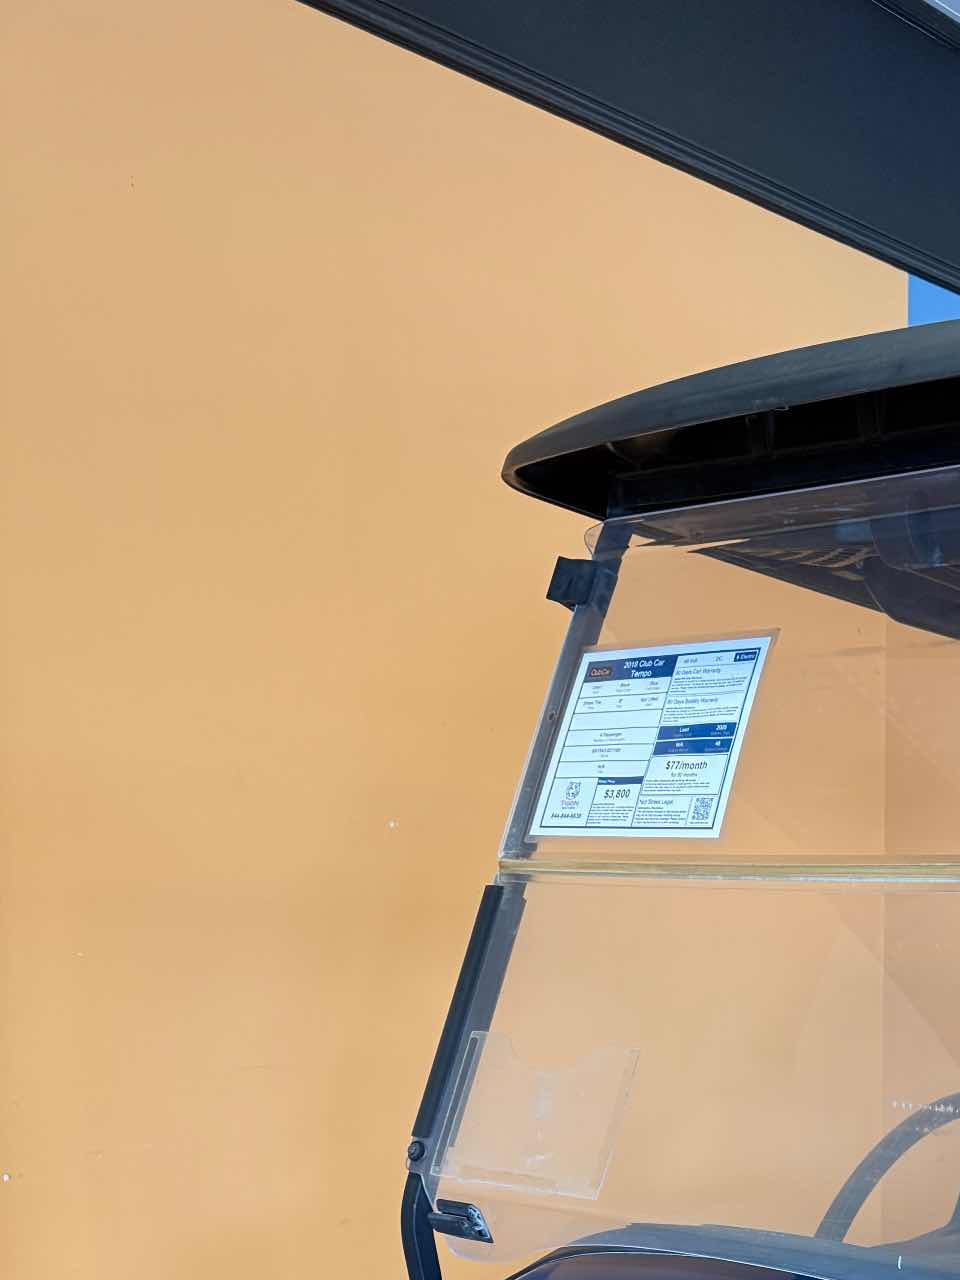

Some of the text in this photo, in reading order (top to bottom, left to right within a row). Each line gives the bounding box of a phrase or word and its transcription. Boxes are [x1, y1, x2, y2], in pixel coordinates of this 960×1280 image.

[639, 659, 653, 668] Club
[653, 658, 665, 667] Car
[631, 669, 652, 679] Tempo
[665, 760, 708, 770] $77/month
[603, 789, 631, 800] $3,800
